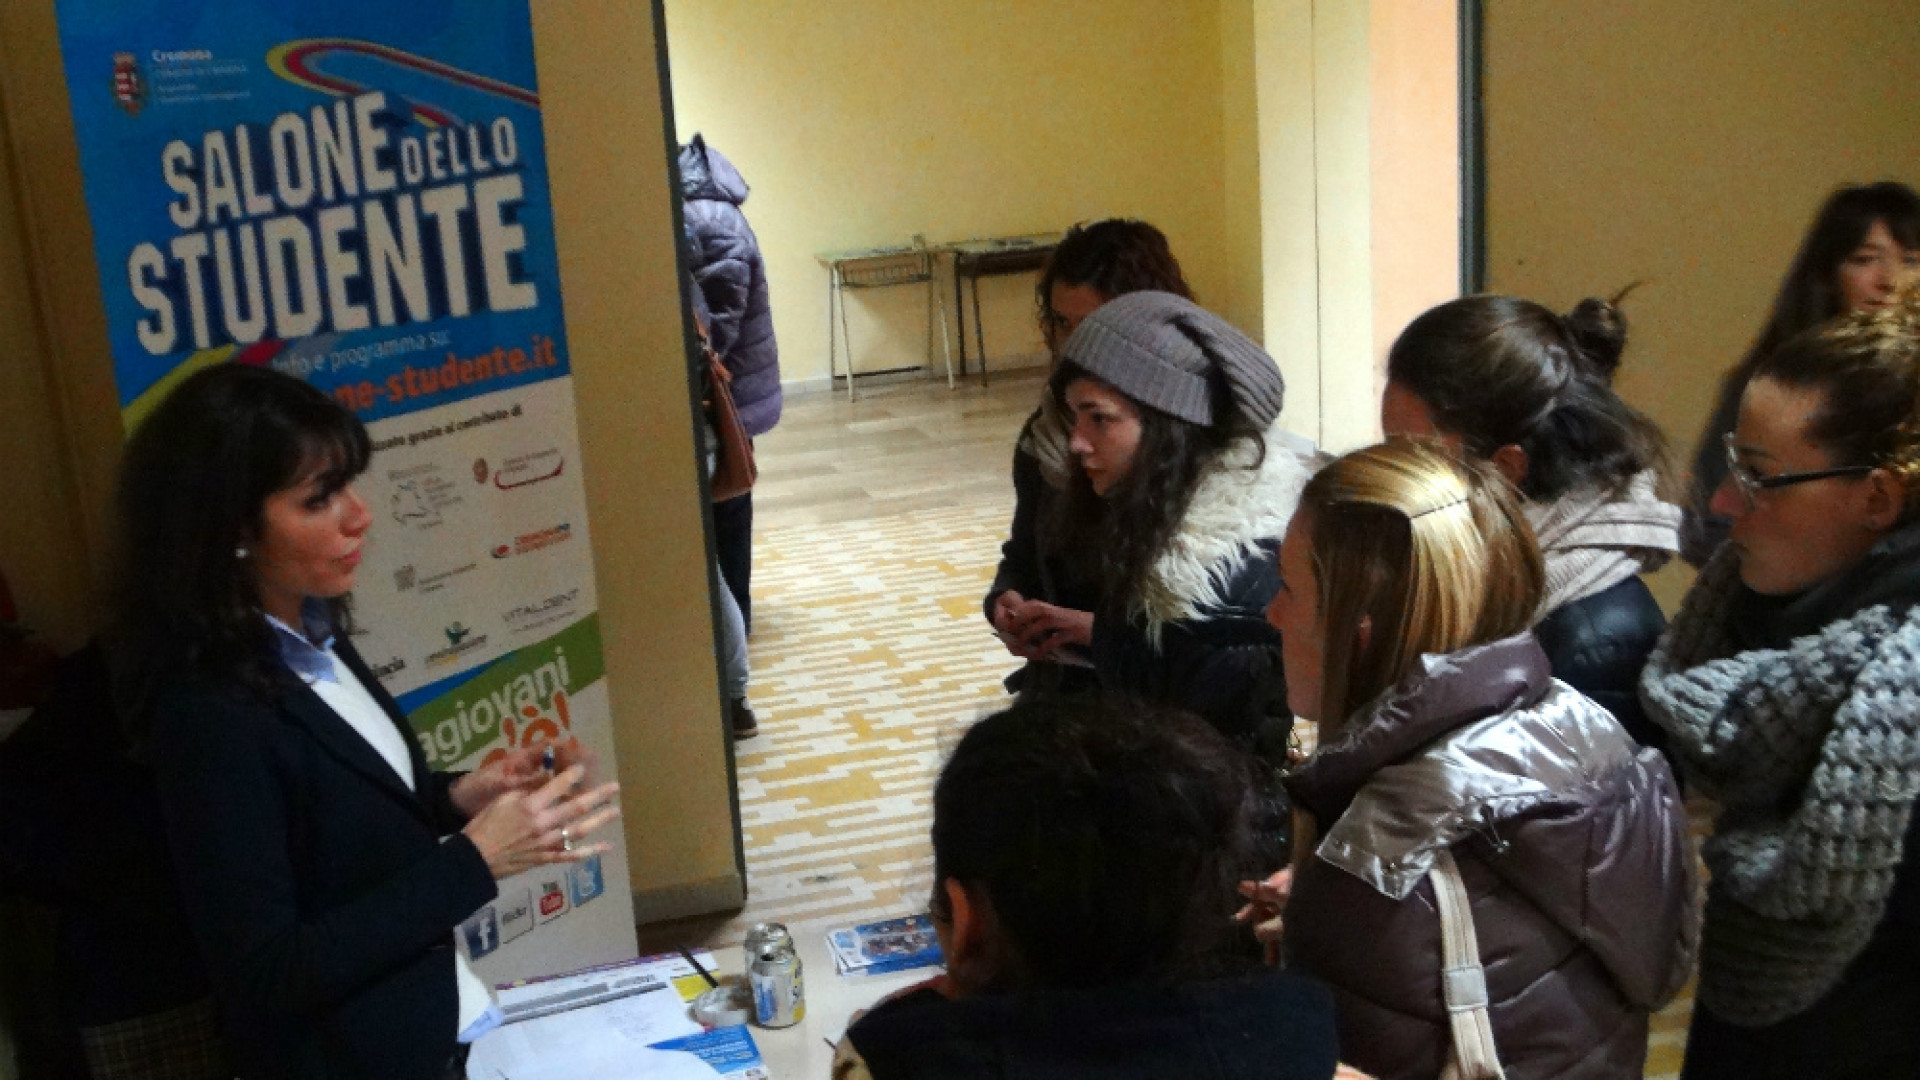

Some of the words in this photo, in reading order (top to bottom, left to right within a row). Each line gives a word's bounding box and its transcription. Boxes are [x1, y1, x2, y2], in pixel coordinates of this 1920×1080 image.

[161, 92, 396, 229] SALONE
[401, 117, 518, 183] DELLO
[128, 173, 537, 356] STUDENTE
[329, 334, 426, 372] programma
[332, 334, 557, 413] ne-studente.it
